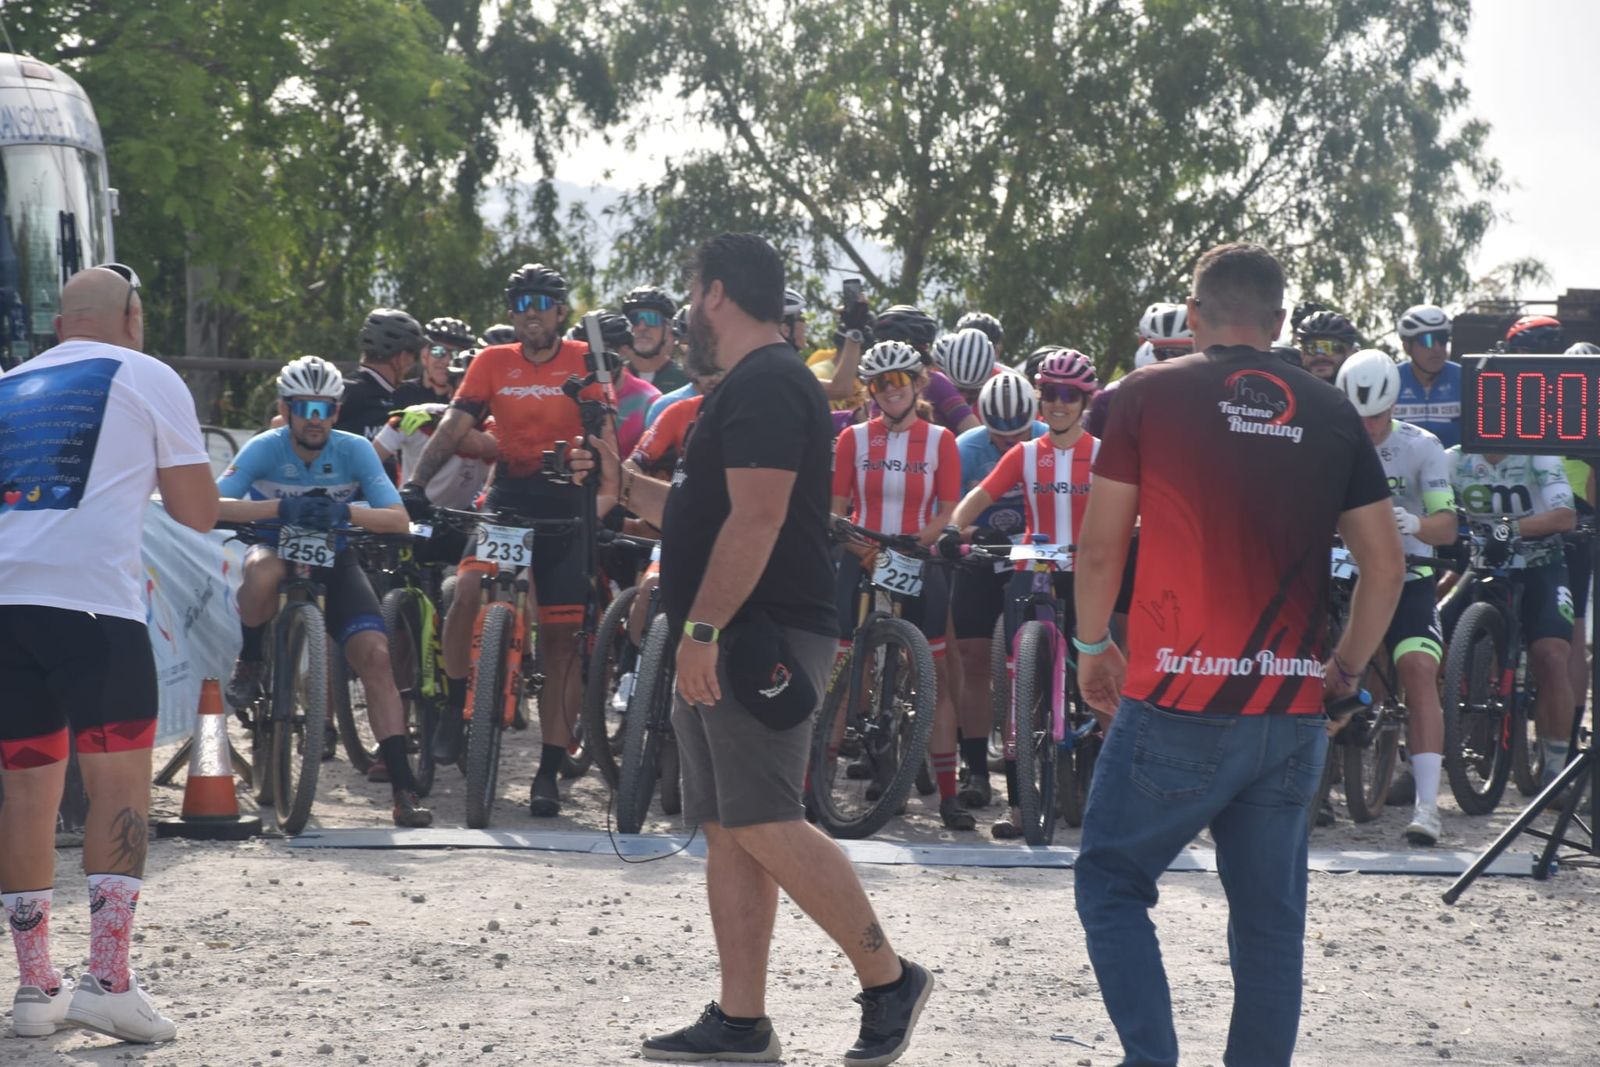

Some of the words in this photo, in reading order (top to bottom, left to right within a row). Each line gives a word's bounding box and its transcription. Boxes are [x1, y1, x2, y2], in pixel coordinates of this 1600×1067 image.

[1218, 400, 1274, 419] Turismo
[1477, 372, 1600, 440] 00:0
[1227, 415, 1304, 443] Running
[1463, 483, 1535, 515] em
[287, 542, 328, 564] 256
[486, 540, 524, 562] 233
[882, 567, 921, 593] 227
[1155, 647, 1254, 676] Turismo
[1255, 649, 1327, 680] Runni
